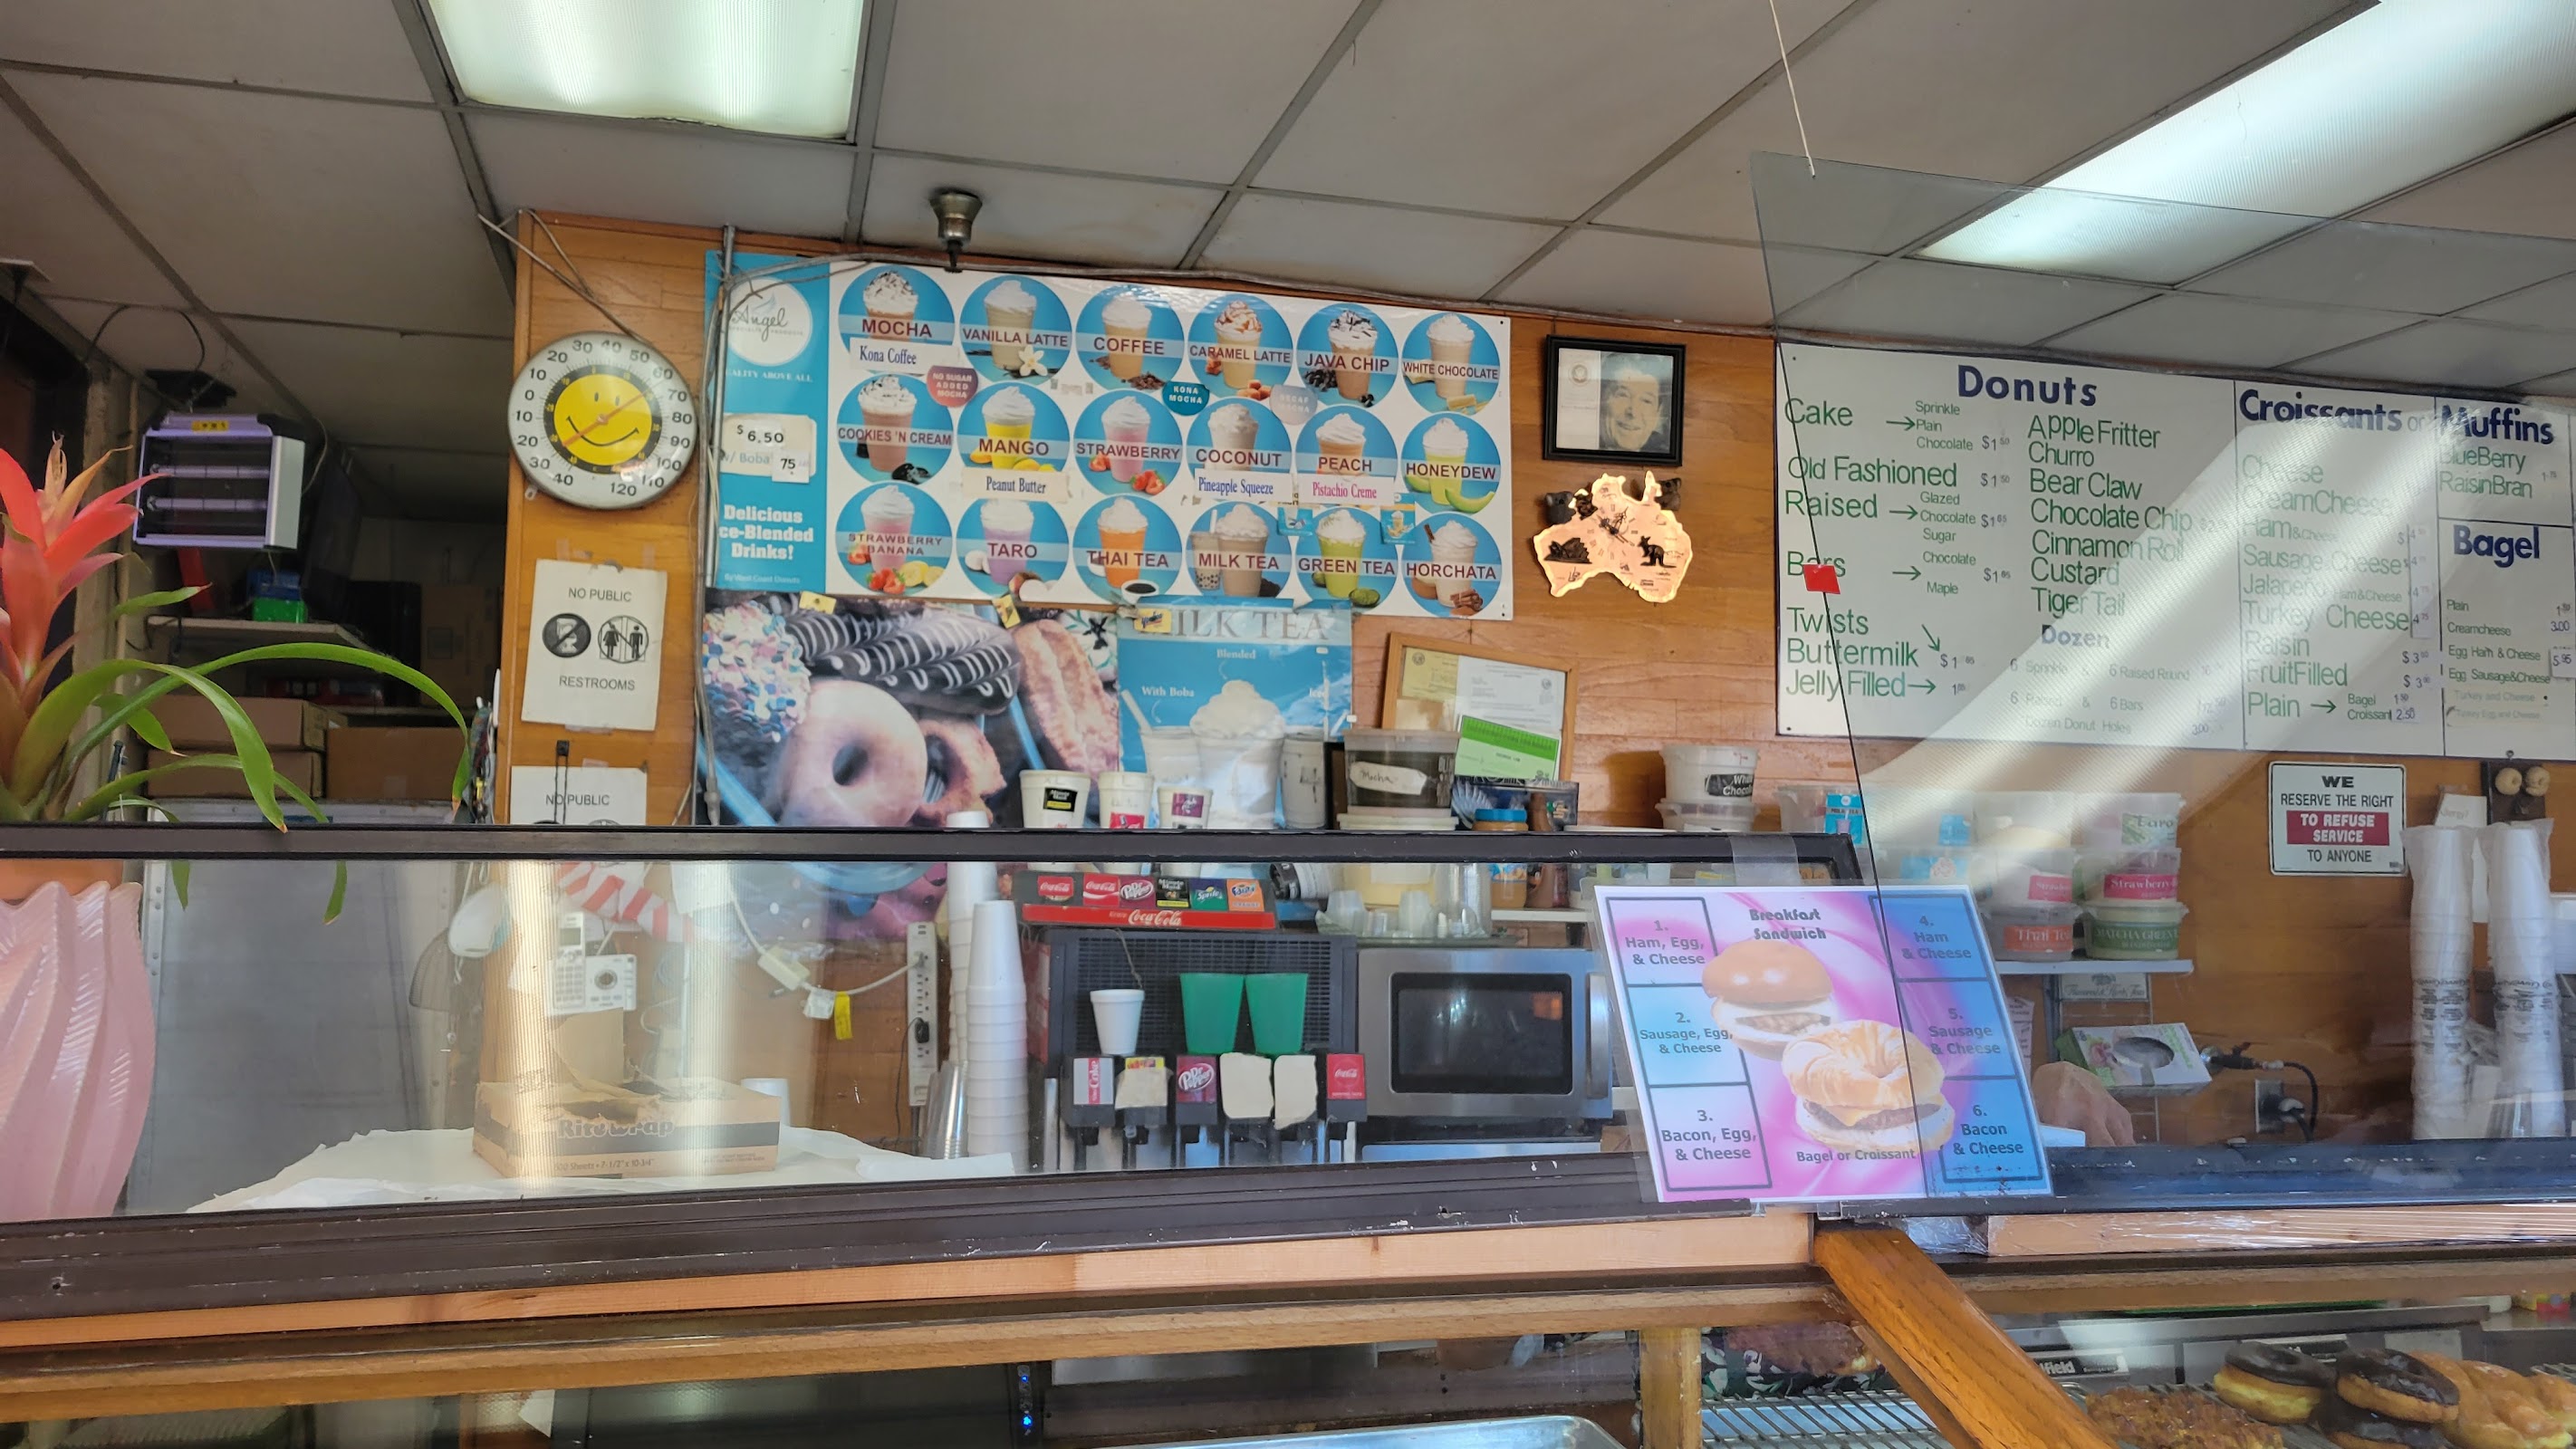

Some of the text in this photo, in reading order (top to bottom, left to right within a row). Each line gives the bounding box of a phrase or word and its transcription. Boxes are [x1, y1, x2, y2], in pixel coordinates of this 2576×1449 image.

[861, 319, 932, 338] MOCHA
[962, 328, 1069, 348] VANILLA LATTE
[1093, 337, 1165, 355] COFFEE
[547, 350, 568, 362] 20
[860, 346, 917, 364] Kona Coffee
[1189, 345, 1292, 364] CARAMEL LATTE
[1305, 354, 1389, 372] JAVA CHIP
[1404, 362, 1499, 379] WHITE CHOCOLATE
[530, 368, 546, 380] 10
[762, 371, 812, 383] ABOVE ALL
[933, 372, 944, 381] NO
[1174, 385, 1198, 394] KONA
[1958, 364, 2097, 407] Donuts
[1168, 395, 1203, 404] MOCHA
[1784, 398, 1853, 427] Cake
[1916, 400, 1960, 416] Sprinkle
[2239, 389, 2402, 432] Croissants
[515, 410, 533, 422] 10
[672, 412, 692, 424] 80
[1917, 418, 1942, 431] Plain
[2028, 414, 2160, 449] Apple Fritter
[2441, 405, 2554, 445] Muffins
[517, 435, 538, 446] 20
[670, 436, 690, 448] 90
[747, 430, 784, 444] 6.50
[838, 427, 951, 446] COOKIES CREAM
[1917, 437, 1973, 451] Chocolate
[979, 438, 1049, 456] MANGO
[1077, 442, 1180, 460] STRAWBERRY
[2028, 440, 2094, 467] Churro
[529, 457, 550, 470] 30
[739, 451, 770, 465] Boba
[1196, 448, 1282, 466] COCONUT
[1318, 457, 1372, 472] PEACH
[2439, 446, 2526, 475] BlueBerry
[1406, 463, 1496, 480] HONEYDEW
[1788, 456, 1957, 486] Old Fashioned
[610, 483, 637, 496] 120
[986, 476, 1046, 494] Peanut Butter
[1198, 476, 1274, 497] Pineapple Squeeze
[1312, 482, 1377, 499] Pistachio Creme
[2030, 467, 2143, 500] Bear Claw
[2439, 471, 2533, 498] RaisinBran
[1785, 490, 1878, 519] Raised
[1920, 491, 1960, 505] Glazed
[724, 504, 803, 523] Delicious
[1920, 510, 1976, 524] Chocolate
[2031, 498, 2193, 534] Chocolate Chip
[718, 524, 813, 542] ce-Blended
[848, 533, 943, 545] STRAWBERRY
[1923, 527, 1956, 543] Sugar
[731, 542, 793, 560] Drinks!
[867, 545, 924, 556] BANANA
[987, 542, 1037, 559] TARO
[2032, 529, 2143, 560] Cinnamon
[2453, 524, 2540, 568] Bagel
[1087, 551, 1169, 568] THAI TEA
[1199, 553, 1280, 570] MILK TEA
[1922, 551, 1976, 565] Chocolate
[2244, 543, 2323, 573] Sausage
[1298, 558, 1395, 575] GREEN TEA
[1406, 562, 1496, 580] HORCHATA
[2031, 556, 2120, 586] Custard
[568, 587, 632, 602] NO PUBLIC
[1927, 581, 1958, 597] Maple
[2031, 587, 2087, 619] Tiger
[2446, 599, 2469, 612] Plain
[1253, 610, 1329, 640] TEA
[1786, 607, 1870, 635] Twists
[2326, 604, 2408, 631] Cheese
[2042, 624, 2110, 648] Dozen
[2447, 622, 2512, 636] Creamcheese
[2244, 629, 2310, 657] Raisin
[1216, 648, 1255, 660] Blended
[1787, 638, 1918, 667] Buttermilk
[2448, 645, 2541, 661] Egg Cheese
[2119, 666, 2155, 679] Raised
[2245, 658, 2348, 686] FruitFilled
[2448, 668, 2466, 682] Egg
[559, 676, 635, 691] RESTROOMS
[1786, 669, 1905, 702] Jelly Filled
[2110, 696, 2143, 711] 6 Bars
[2248, 692, 2301, 718] Plain
[2348, 694, 2376, 707] Bagel
[2347, 710, 2392, 721] Croissant
[2064, 717, 2096, 731] Donut
[1361, 769, 1394, 784] Mocha
[2321, 775, 2354, 788] WE
[545, 794, 610, 805] NO PUBLIC
[2281, 793, 2394, 808] RESERVE THE RIGHT
[2300, 813, 2375, 827] TO REFUSE
[2313, 830, 2364, 843] SERVICE
[2307, 849, 2372, 863] TO ANYONE
[1085, 881, 1116, 892] Coca-Cola
[1197, 889, 1220, 902] Sprite
[1129, 909, 1181, 926] Coca-Cola
[1749, 908, 1821, 921] Breakfast
[1754, 927, 1827, 940] Sandwich
[1914, 932, 1948, 943] Ham
[1625, 936, 1705, 951] Ham, Egg,
[1649, 954, 1706, 965] Cheese
[1919, 948, 1971, 959] Cheese
[1676, 1012, 1690, 1023] 2.
[1639, 1028, 1734, 1041] Sausage, Egg,
[1928, 1026, 1993, 1039] Sausage
[1674, 1043, 1721, 1053] Cheese
[1947, 1043, 2000, 1054] Cheese
[1090, 1060, 1100, 1089] Coke
[1179, 1070, 1212, 1091] Pepper
[1191, 1067, 1204, 1080] Dr
[1334, 1069, 1357, 1078] Coca-Cola
[1697, 1109, 1714, 1122] 3.
[1661, 1128, 1756, 1143] Bacon, Egg,
[1961, 1124, 2007, 1136] Bacon
[1693, 1147, 1751, 1160] Cheese
[1797, 1149, 1916, 1164] Bagel or Croissant
[1969, 1143, 2023, 1155] Cheese
